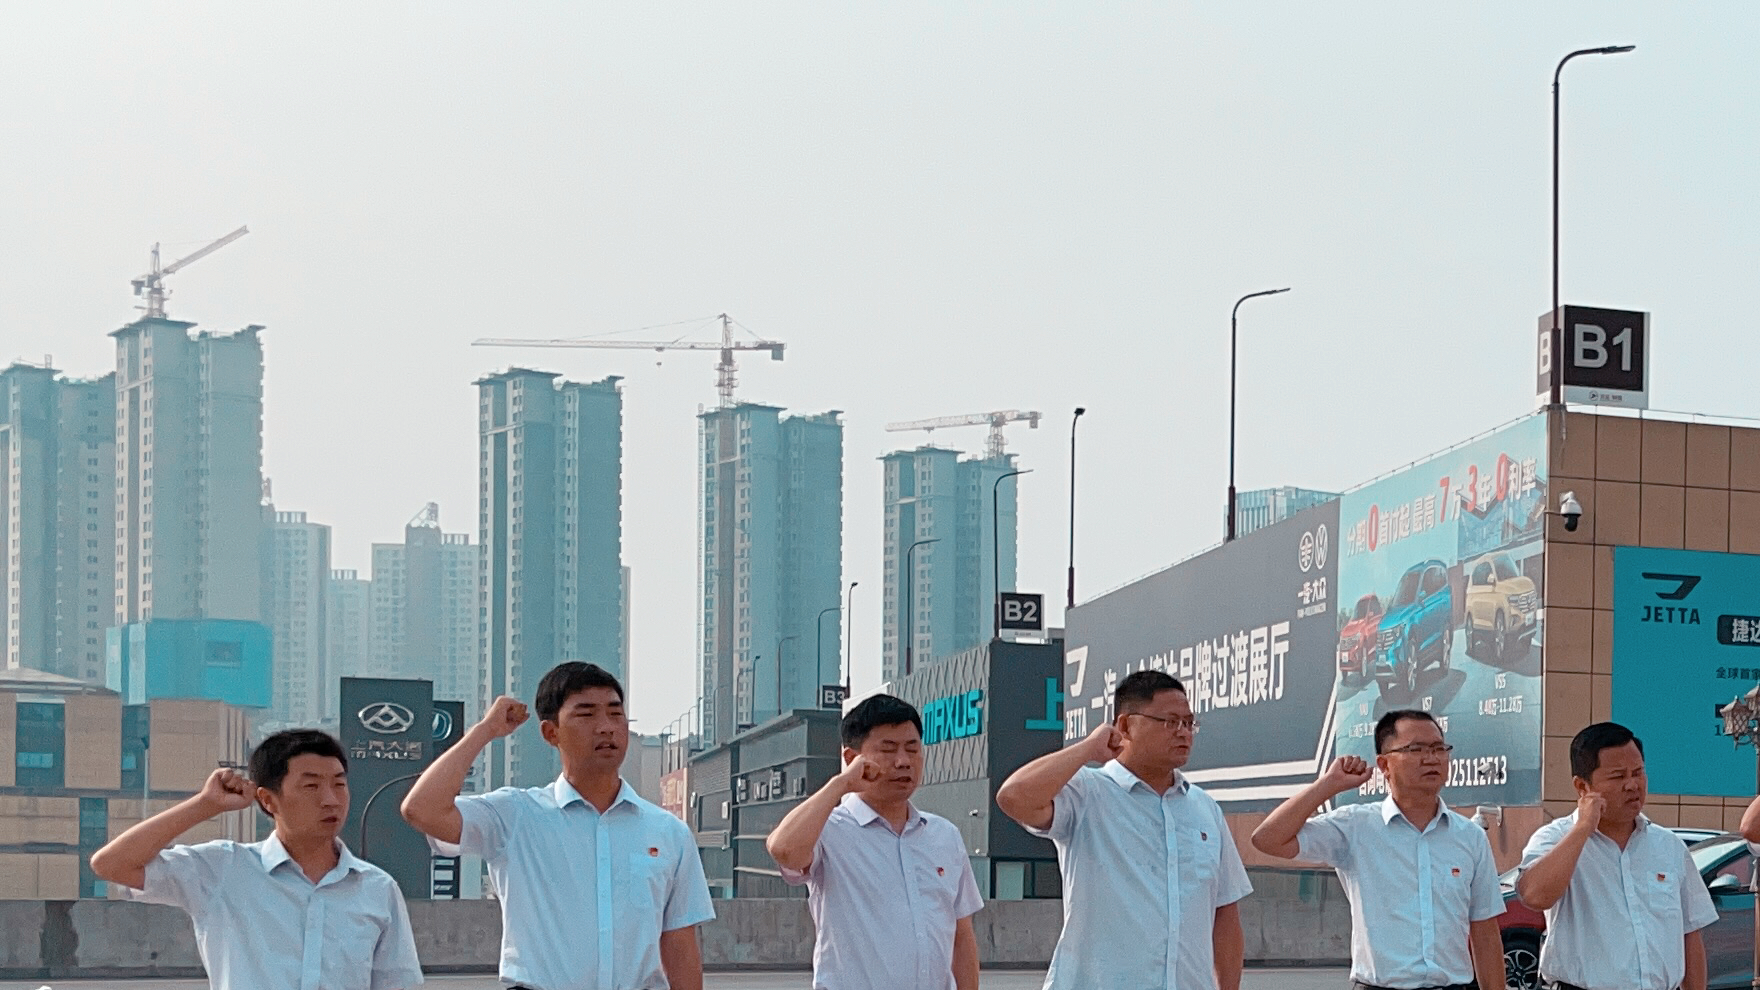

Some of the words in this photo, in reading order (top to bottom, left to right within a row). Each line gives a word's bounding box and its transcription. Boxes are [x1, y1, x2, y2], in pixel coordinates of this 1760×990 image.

[1574, 323, 1632, 372] B1
[1004, 600, 1037, 622] B2
[1641, 605, 1700, 624] JETTA
[824, 690, 846, 704] B3
[922, 688, 984, 746] MAXUS
[1065, 707, 1087, 741] JETTA
